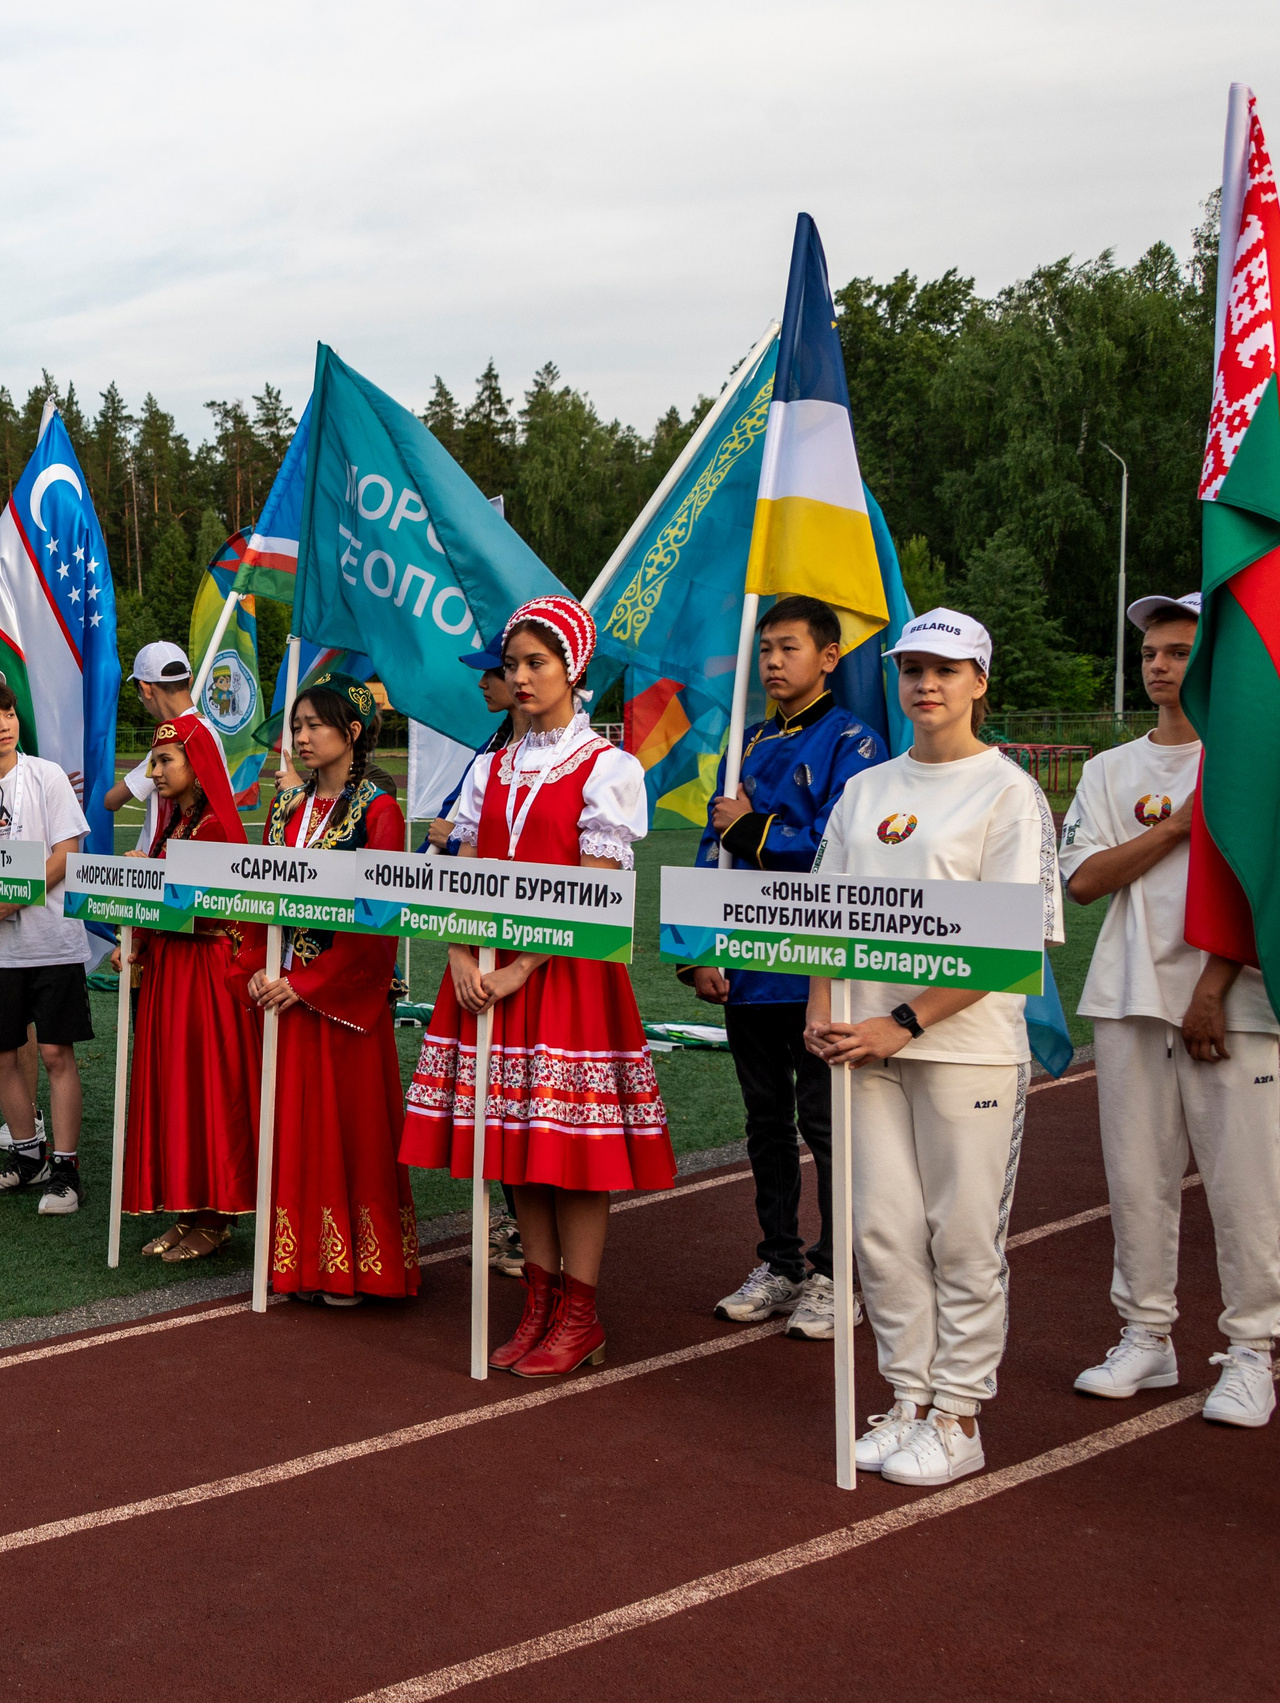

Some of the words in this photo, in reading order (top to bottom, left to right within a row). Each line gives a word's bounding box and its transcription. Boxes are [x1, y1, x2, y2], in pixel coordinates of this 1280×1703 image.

[910, 622, 962, 636] BELARUS
[75, 864, 124, 887] «МОРСКИЕ
[230, 857, 318, 884] «САРМАТ»
[364, 862, 434, 891] «ЮНЫЙ
[439, 870, 511, 898] ГЕОЛОГ
[515, 877, 623, 909] БУРЯТИИ»
[194, 890, 275, 916] Республика
[278, 898, 355, 924] Казахстан
[760, 881, 831, 903] «ЮНЫЕ
[836, 884, 923, 908] ГЕОЛОГИ
[87, 897, 134, 920] Республика
[134, 903, 160, 923] Крым
[723, 904, 844, 930] РЕСПУБЛИКИ
[848, 911, 962, 937] БЕЛАРУСЬ»
[400, 907, 498, 938] Республика
[502, 918, 574, 947] Бурятия
[715, 933, 846, 968] Республика
[854, 944, 972, 980] Беларусь
